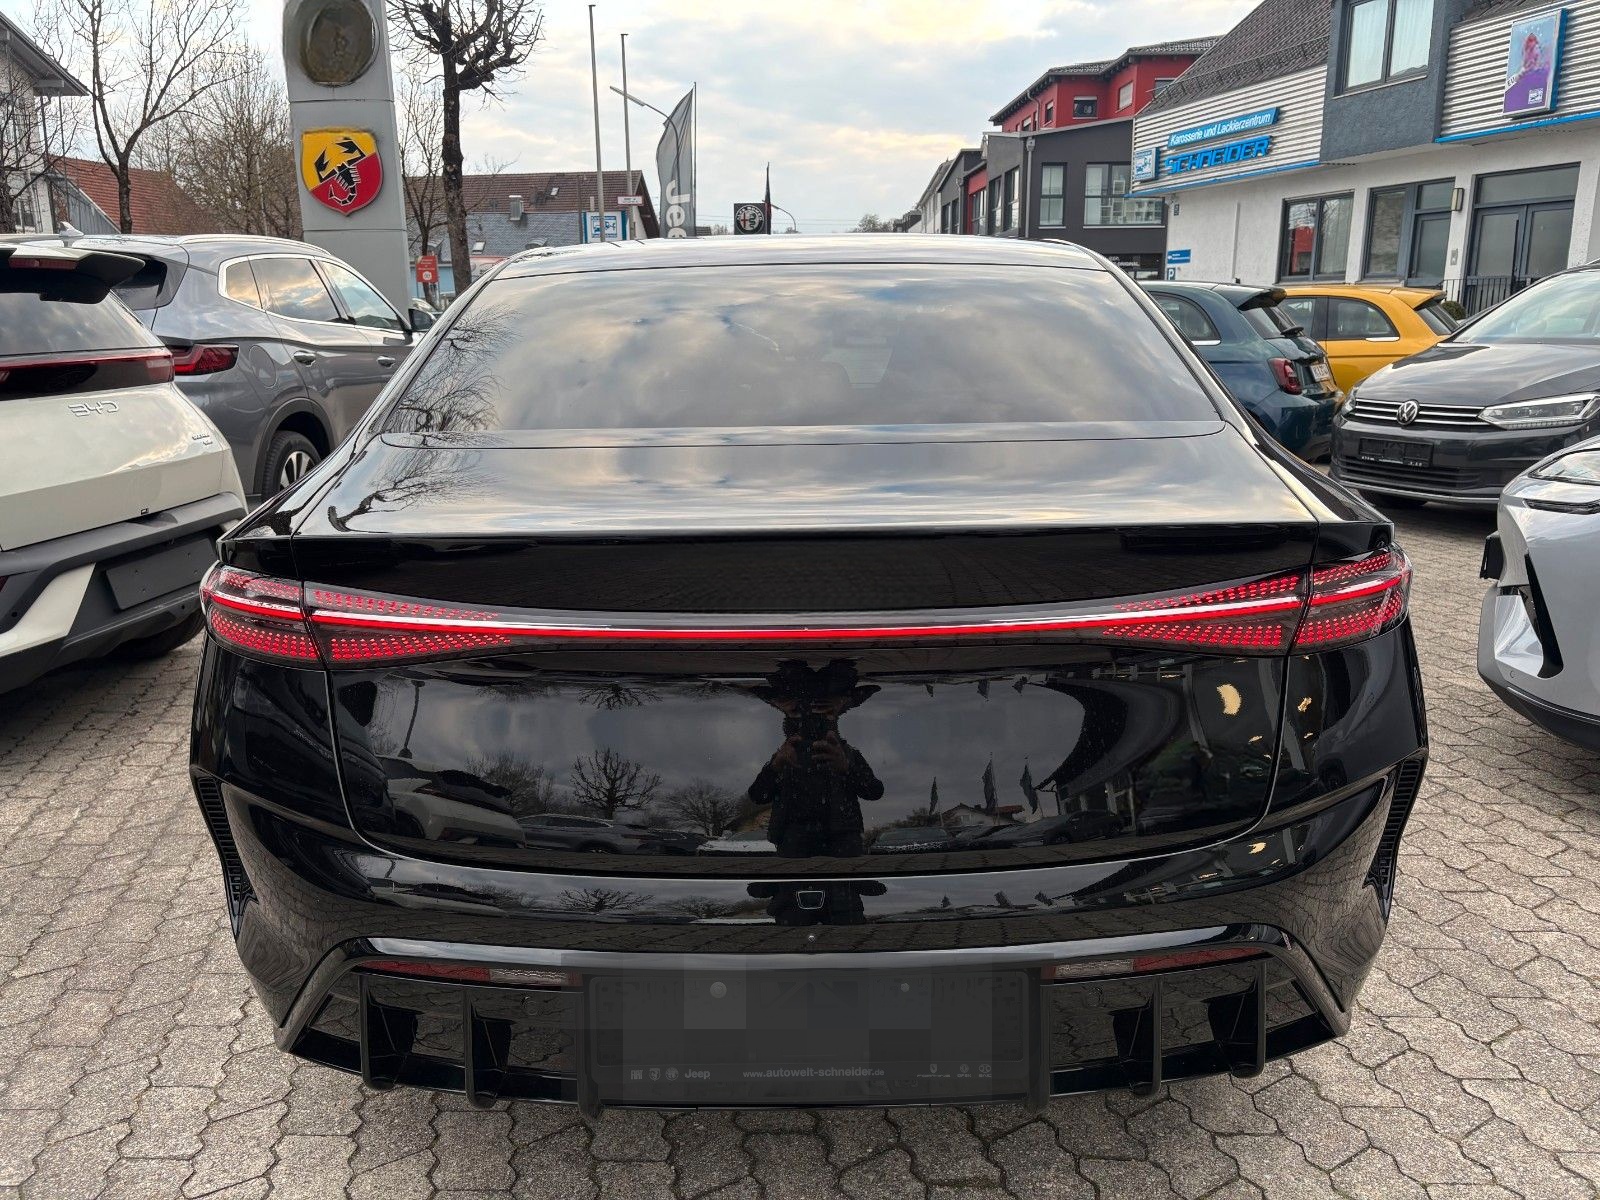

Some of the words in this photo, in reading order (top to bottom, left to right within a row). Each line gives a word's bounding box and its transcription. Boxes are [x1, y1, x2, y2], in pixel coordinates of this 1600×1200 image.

[1170, 128, 1203, 146] Karosserie
[1203, 125, 1217, 138] und
[1217, 113, 1271, 135] Lackierzentrum
[1164, 135, 1271, 175] SCHNEIDER
[684, 1068, 711, 1080] Jeep
[742, 1066, 885, 1078] www.autowelt-schneider.de
